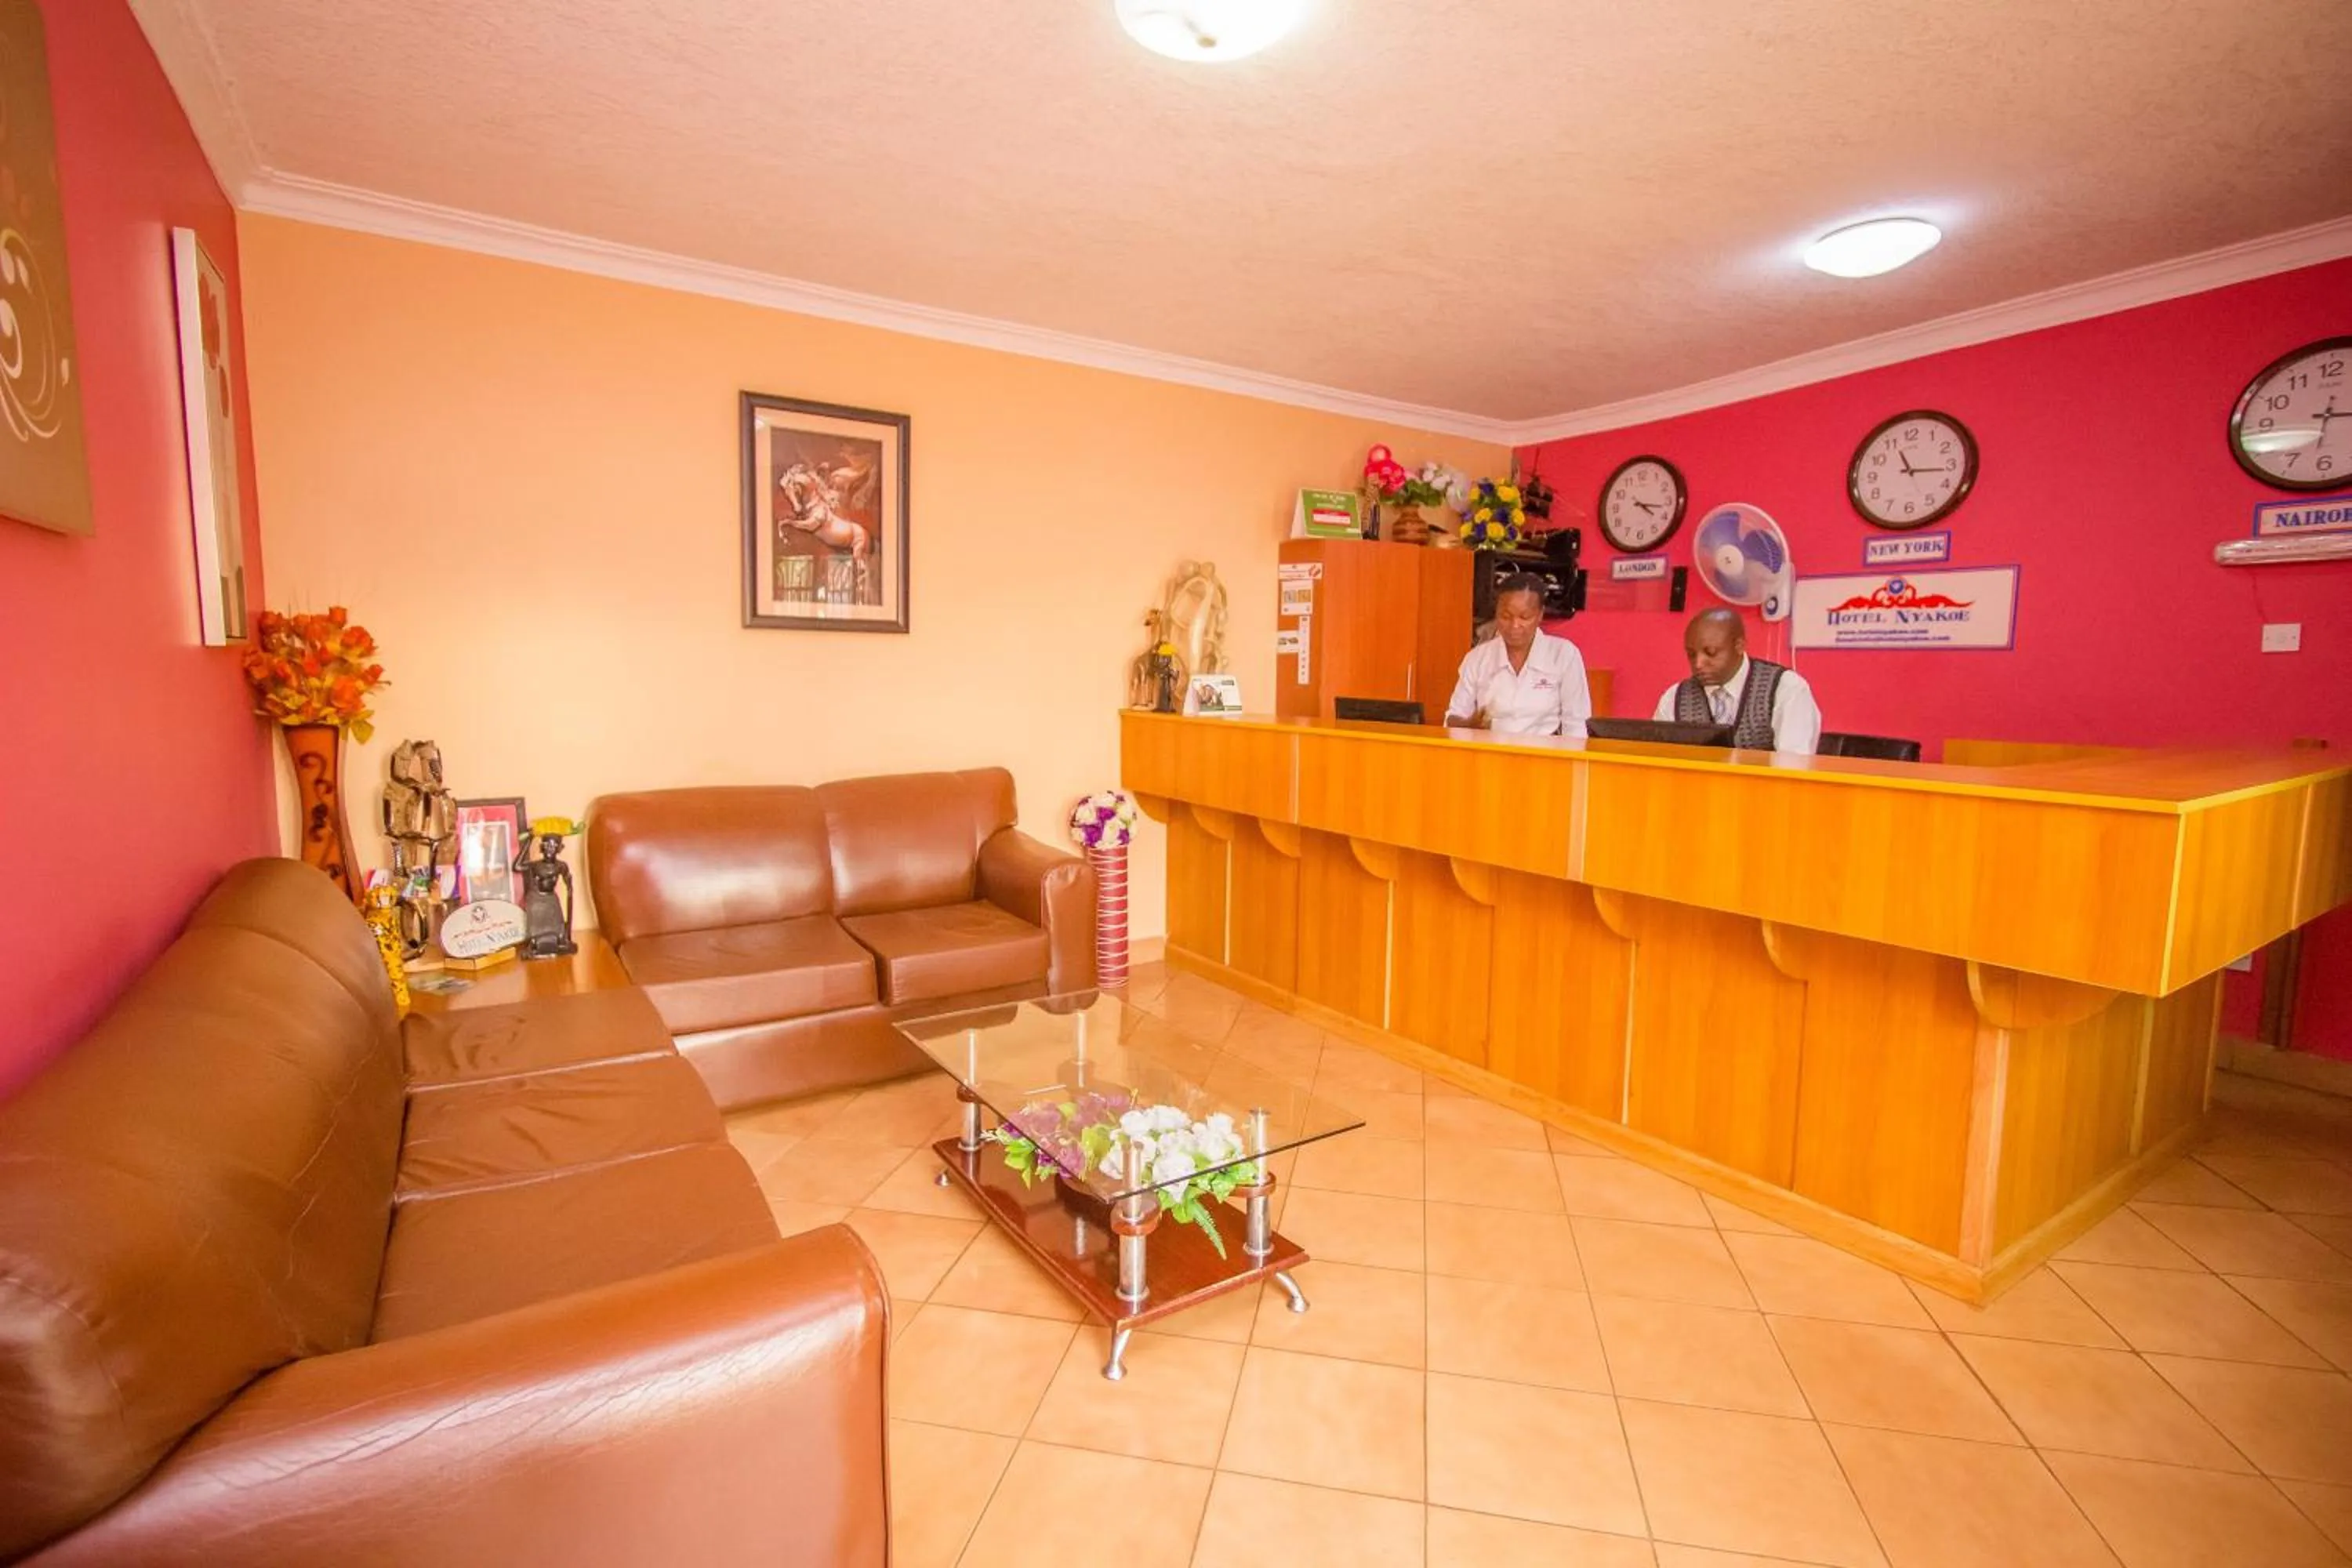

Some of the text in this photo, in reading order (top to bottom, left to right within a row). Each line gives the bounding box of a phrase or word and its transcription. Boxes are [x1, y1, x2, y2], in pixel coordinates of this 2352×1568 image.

[2318, 360, 2345, 379] 12
[2288, 373, 2308, 390] 11
[2265, 394, 2290, 412] 10
[2259, 417, 2274, 433] 9
[1904, 427, 1919, 441] 12
[1929, 430, 1935, 441] 1
[1885, 438, 1897, 450] 11
[1940, 441, 1951, 454] 2
[1872, 455, 1886, 466] 10
[1946, 458, 1957, 471] 3
[2285, 452, 2302, 468] 7
[2316, 455, 2332, 471] 6
[1624, 477, 1633, 487] 11
[1637, 471, 1647, 481] 12
[1867, 472, 1878, 484] 9
[1661, 481, 1669, 493] 2
[1940, 477, 1950, 489] 4
[1615, 489, 1625, 500] 10
[1871, 488, 1880, 499] 8
[1885, 499, 1894, 511] 7
[1924, 494, 1935, 506] 5
[1612, 503, 1620, 514] 9
[1904, 502, 1915, 514] 6
[1661, 511, 1668, 521] 4
[1624, 527, 1631, 537] 7
[1636, 529, 1644, 540] 6
[1650, 524, 1659, 534] 5
[1870, 539, 1944, 557] NEW YORK
[1618, 562, 1657, 573] LONDON
[1828, 610, 1971, 626] HOTEL NYAKOE
